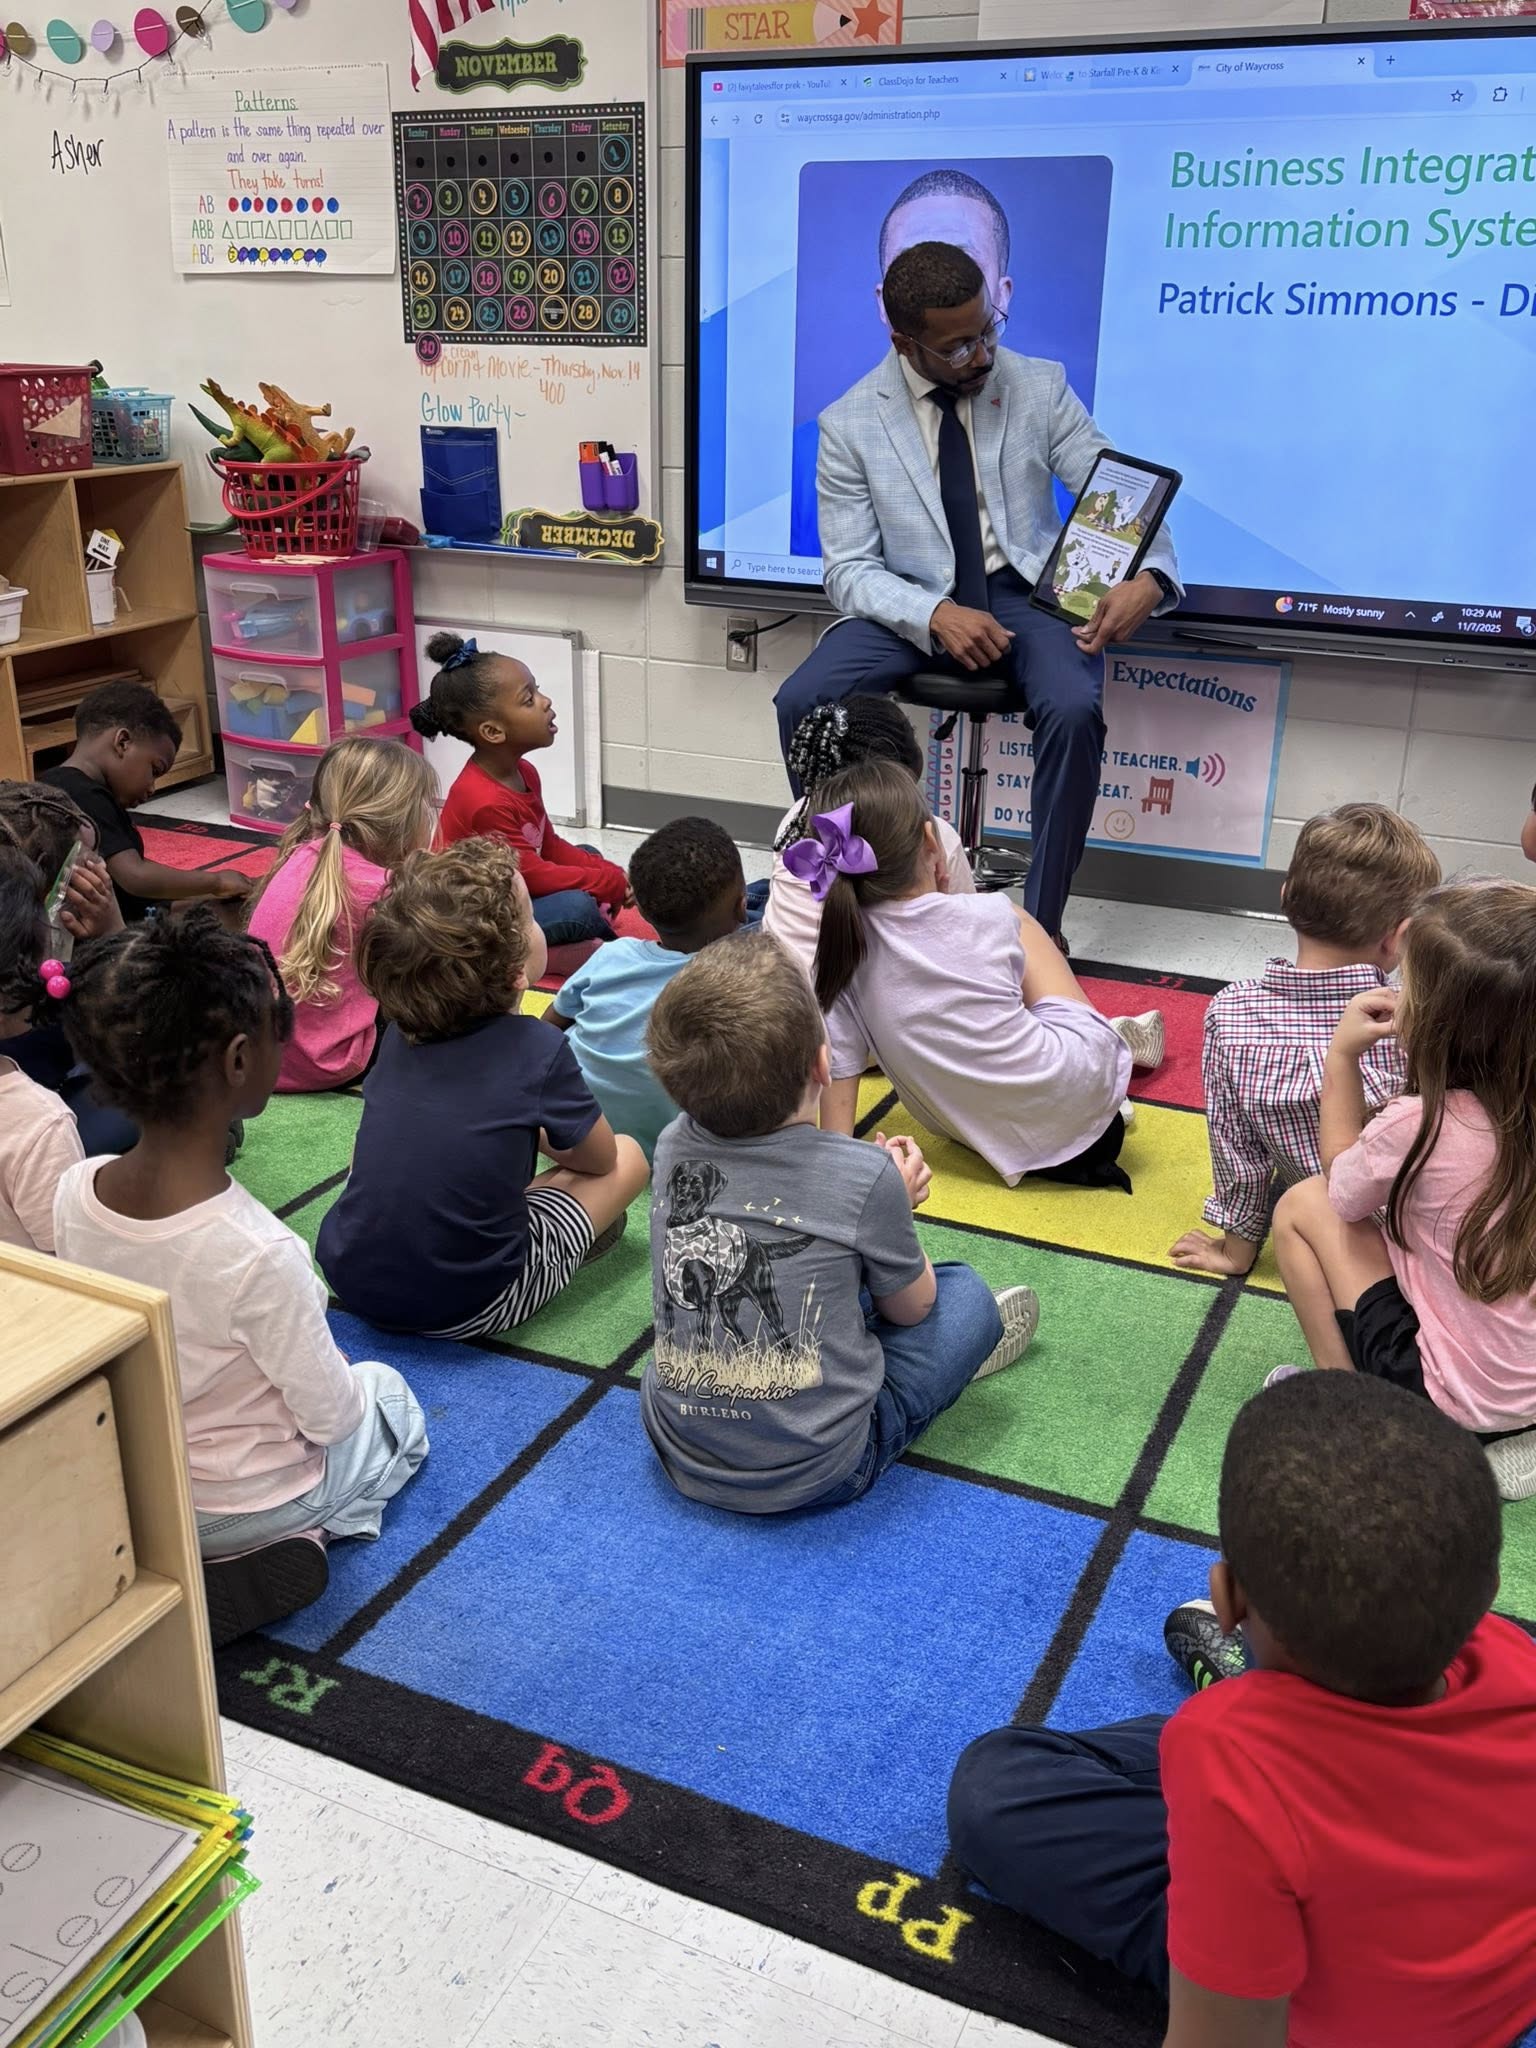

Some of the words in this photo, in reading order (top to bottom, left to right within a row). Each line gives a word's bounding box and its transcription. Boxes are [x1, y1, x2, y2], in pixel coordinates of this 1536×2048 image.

[723, 11, 792, 41] STAR
[455, 52, 558, 78] NOVEMBER
[1089, 67, 1115, 78] Starfall
[1117, 66, 1140, 77] Pre-K
[1141, 66, 1149, 76] &
[1216, 62, 1231, 73] City
[1234, 62, 1243, 71] of
[1245, 60, 1284, 72] Waycross
[878, 77, 914, 87] ClassDojo
[915, 76, 927, 86] for
[927, 74, 959, 84] Teachers
[235, 90, 297, 111] Patterns
[602, 120, 630, 132] Saturday
[797, 110, 940, 125] waycrossga.gov/administration.php
[168, 119, 176, 139] A
[180, 120, 216, 144] pattern
[222, 126, 229, 137] is
[233, 117, 251, 137] the
[256, 126, 283, 137] same
[286, 116, 311, 142] thing
[317, 116, 355, 140] repeated
[362, 124, 385, 135] over
[51, 130, 104, 175] Asher
[227, 144, 244, 163] and
[251, 152, 272, 163] over
[278, 151, 307, 169] again.
[609, 145, 620, 162] 1
[1171, 148, 1345, 188] Business
[1360, 146, 1536, 195] Integrat
[227, 169, 259, 195] They
[262, 170, 286, 190] take
[293, 169, 325, 189] turns!
[199, 195, 214, 214] AB
[413, 194, 424, 209] 2
[444, 187, 452, 204] 3
[478, 187, 487, 204] 4
[511, 188, 520, 205] 5
[547, 191, 556, 207] 6
[581, 189, 590, 204] 7
[614, 187, 622, 203] 8
[191, 219, 214, 239] ABB
[417, 230, 426, 243] 9
[448, 231, 461, 246] 10
[480, 231, 493, 247] 11
[509, 231, 524, 246] 12
[543, 230, 558, 245] 13
[576, 228, 592, 244] 14
[612, 227, 626, 243] 15
[1164, 208, 1410, 249] Information
[1424, 209, 1536, 259] Syste
[191, 243, 214, 264] ABC
[415, 269, 428, 284] 16
[449, 268, 463, 284] 17
[480, 270, 494, 286] 18
[512, 266, 527, 283] 19
[543, 267, 558, 283] 20
[577, 272, 591, 284] 21
[613, 266, 629, 283] 22
[1158, 281, 1274, 315] Patrick
[1285, 281, 1457, 317] Simmons
[416, 304, 430, 319] 23
[449, 305, 465, 321] 24
[482, 306, 496, 322] 25
[513, 303, 528, 319] 26
[578, 303, 593, 319] 28
[614, 307, 628, 323] 29
[421, 340, 435, 354] 30
[488, 355, 532, 378] Movie
[629, 361, 640, 380] 14
[421, 392, 463, 423] Glow
[468, 395, 512, 439] Party
[100, 536, 111, 546] ONE
[541, 525, 636, 549] DECEMBER
[747, 562, 766, 573] Type
[767, 564, 786, 573] here
[788, 566, 796, 574] to
[1297, 602, 1317, 613] 71°F
[1323, 605, 1353, 618] Mostly
[1355, 609, 1385, 620] sunny
[1461, 608, 1485, 618] 10:29
[1485, 609, 1502, 619] AM
[1457, 622, 1502, 633] 11/7/2025
[1112, 661, 1258, 713] Expectations
[1000, 741, 1034, 757] LISTE
[1113, 752, 1182, 772] TEACHER.
[997, 773, 1032, 789] STAY
[994, 807, 1013, 820] DO
[657, 1361, 695, 1397] Field
[694, 1369, 799, 1408] Companion
[240, 1658, 341, 1714] Rr
[856, 1873, 975, 1964] Pp
